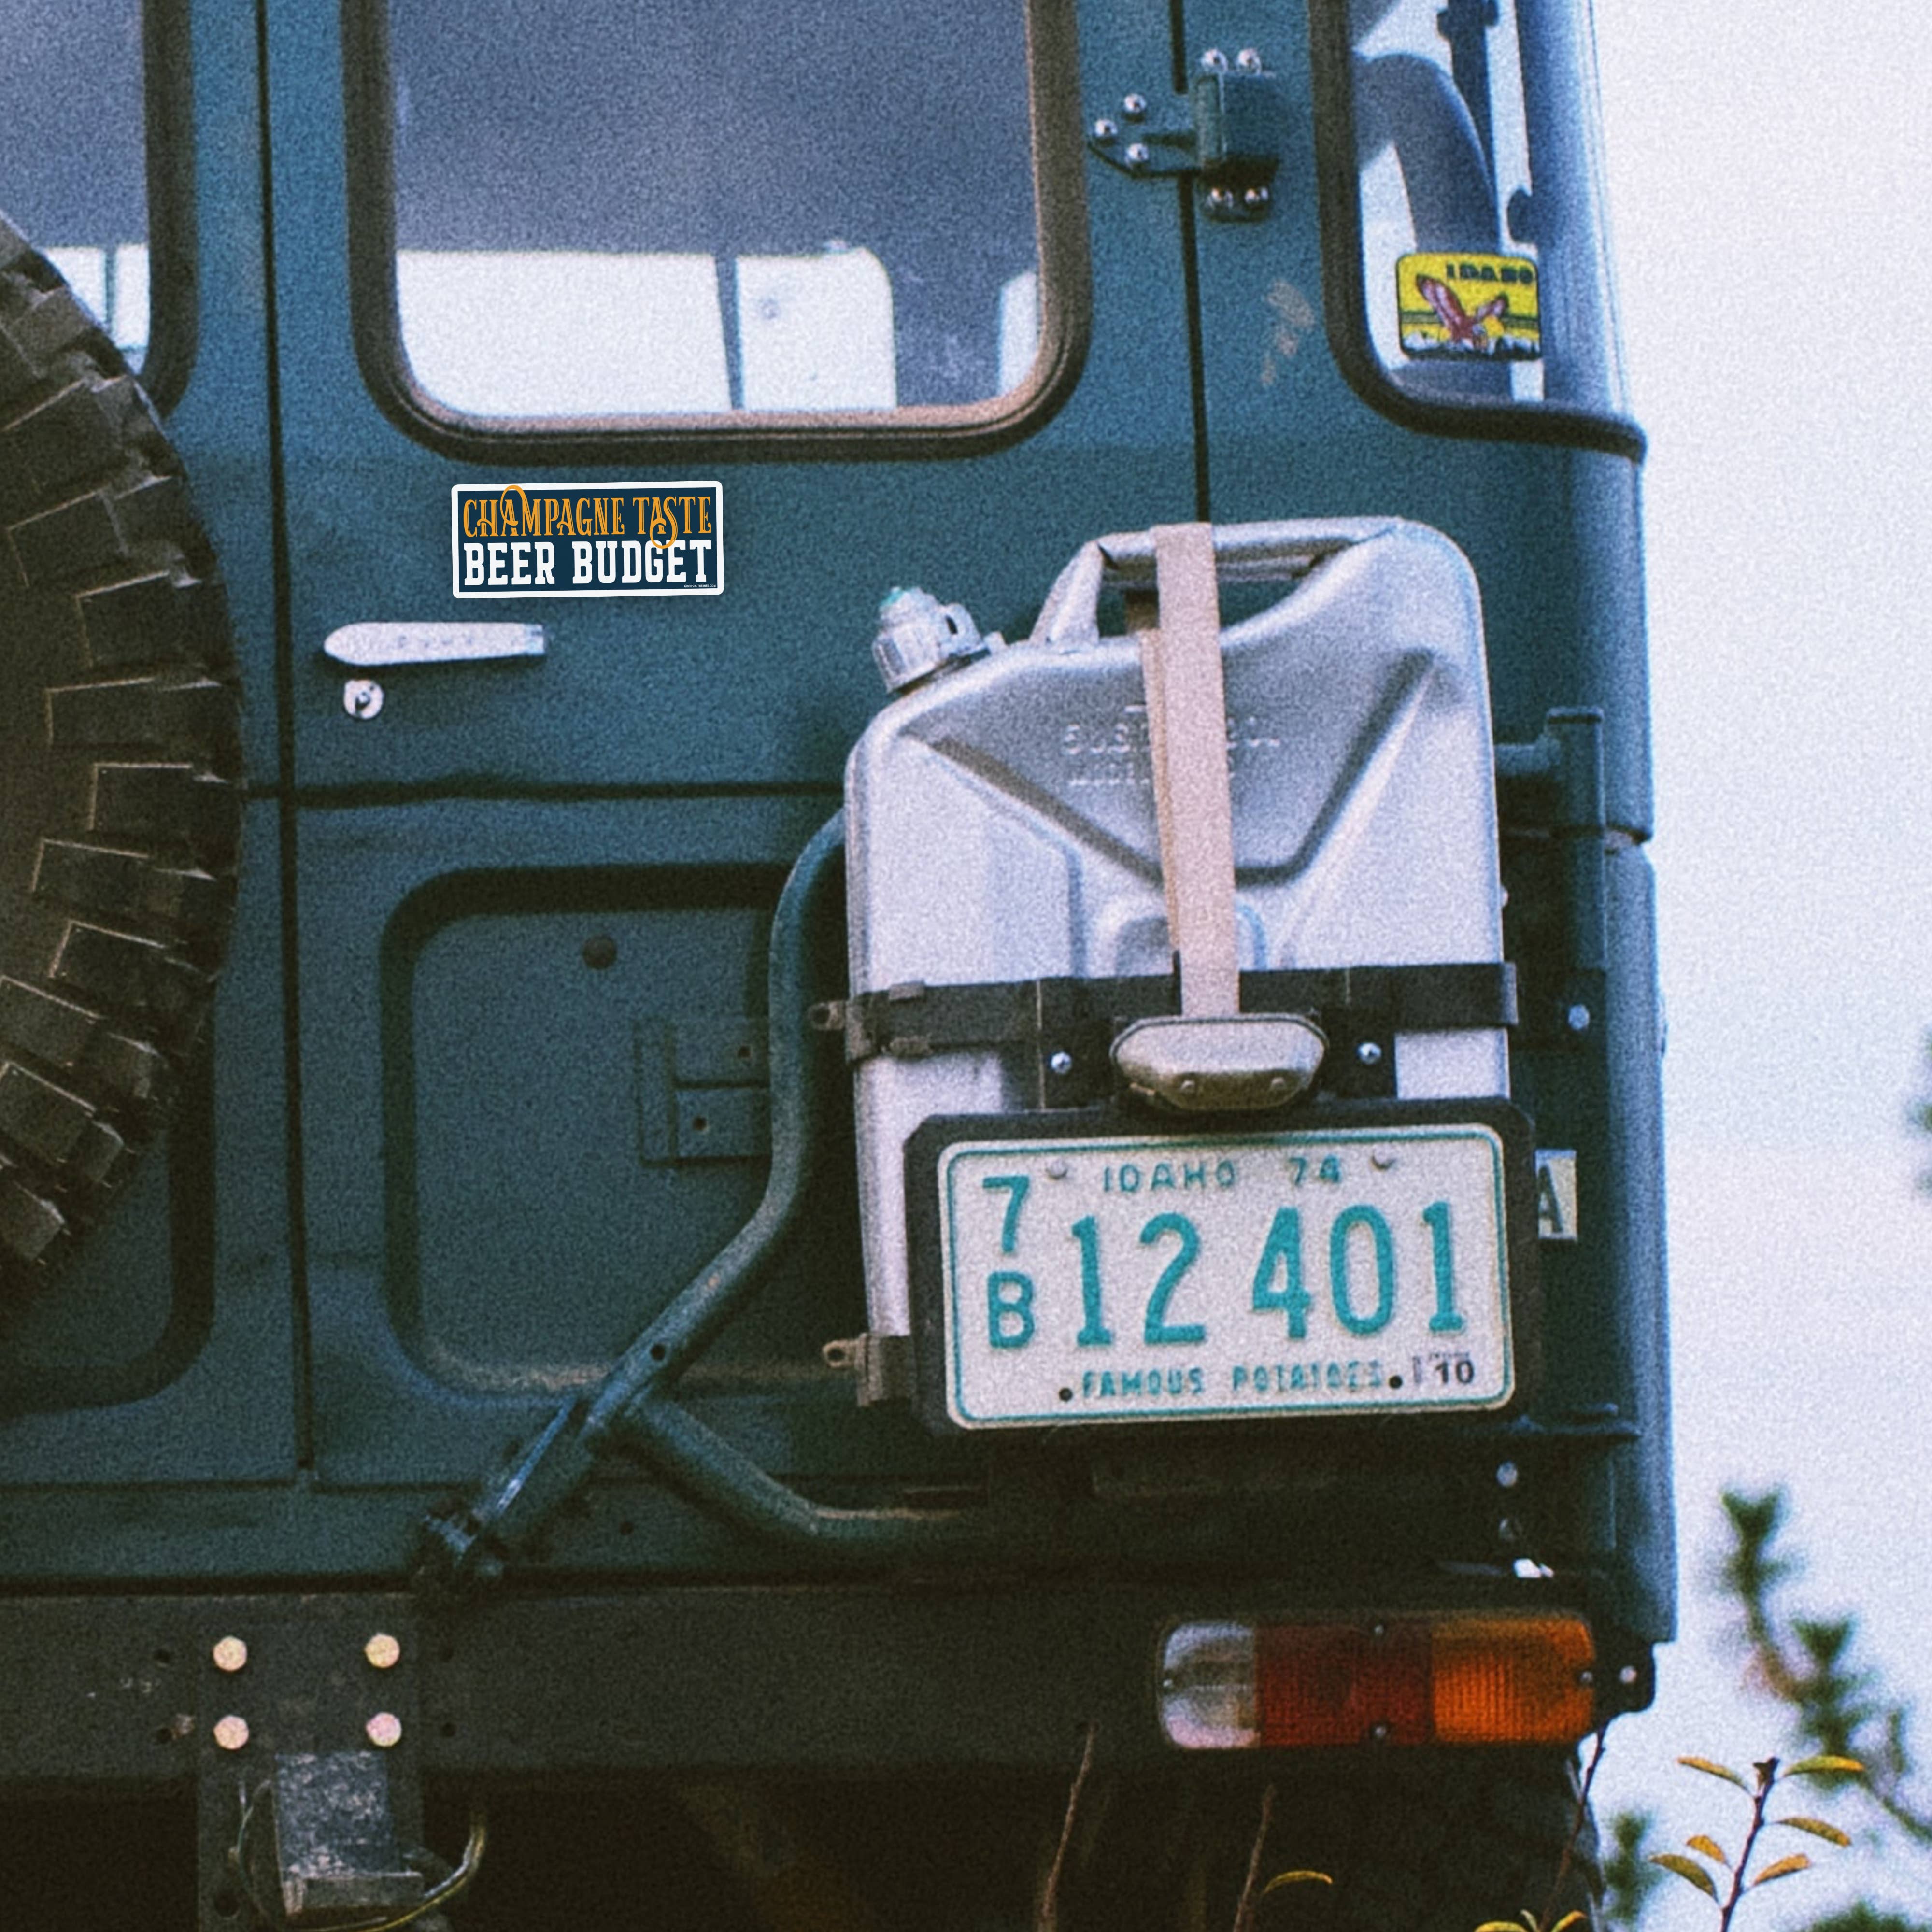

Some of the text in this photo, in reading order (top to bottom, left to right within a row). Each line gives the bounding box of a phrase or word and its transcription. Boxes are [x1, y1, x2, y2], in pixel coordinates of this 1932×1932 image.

[463, 485, 711, 549] CHAMPAGNE TASTE
[465, 540, 711, 585] BEER BUDGET
[1103, 1156, 1341, 1193] IDAHO 74
[1083, 1369, 1204, 1397] FAMOUS
[1232, 1361, 1383, 1393] POTATOES
[1435, 1360, 1474, 1383] 10
